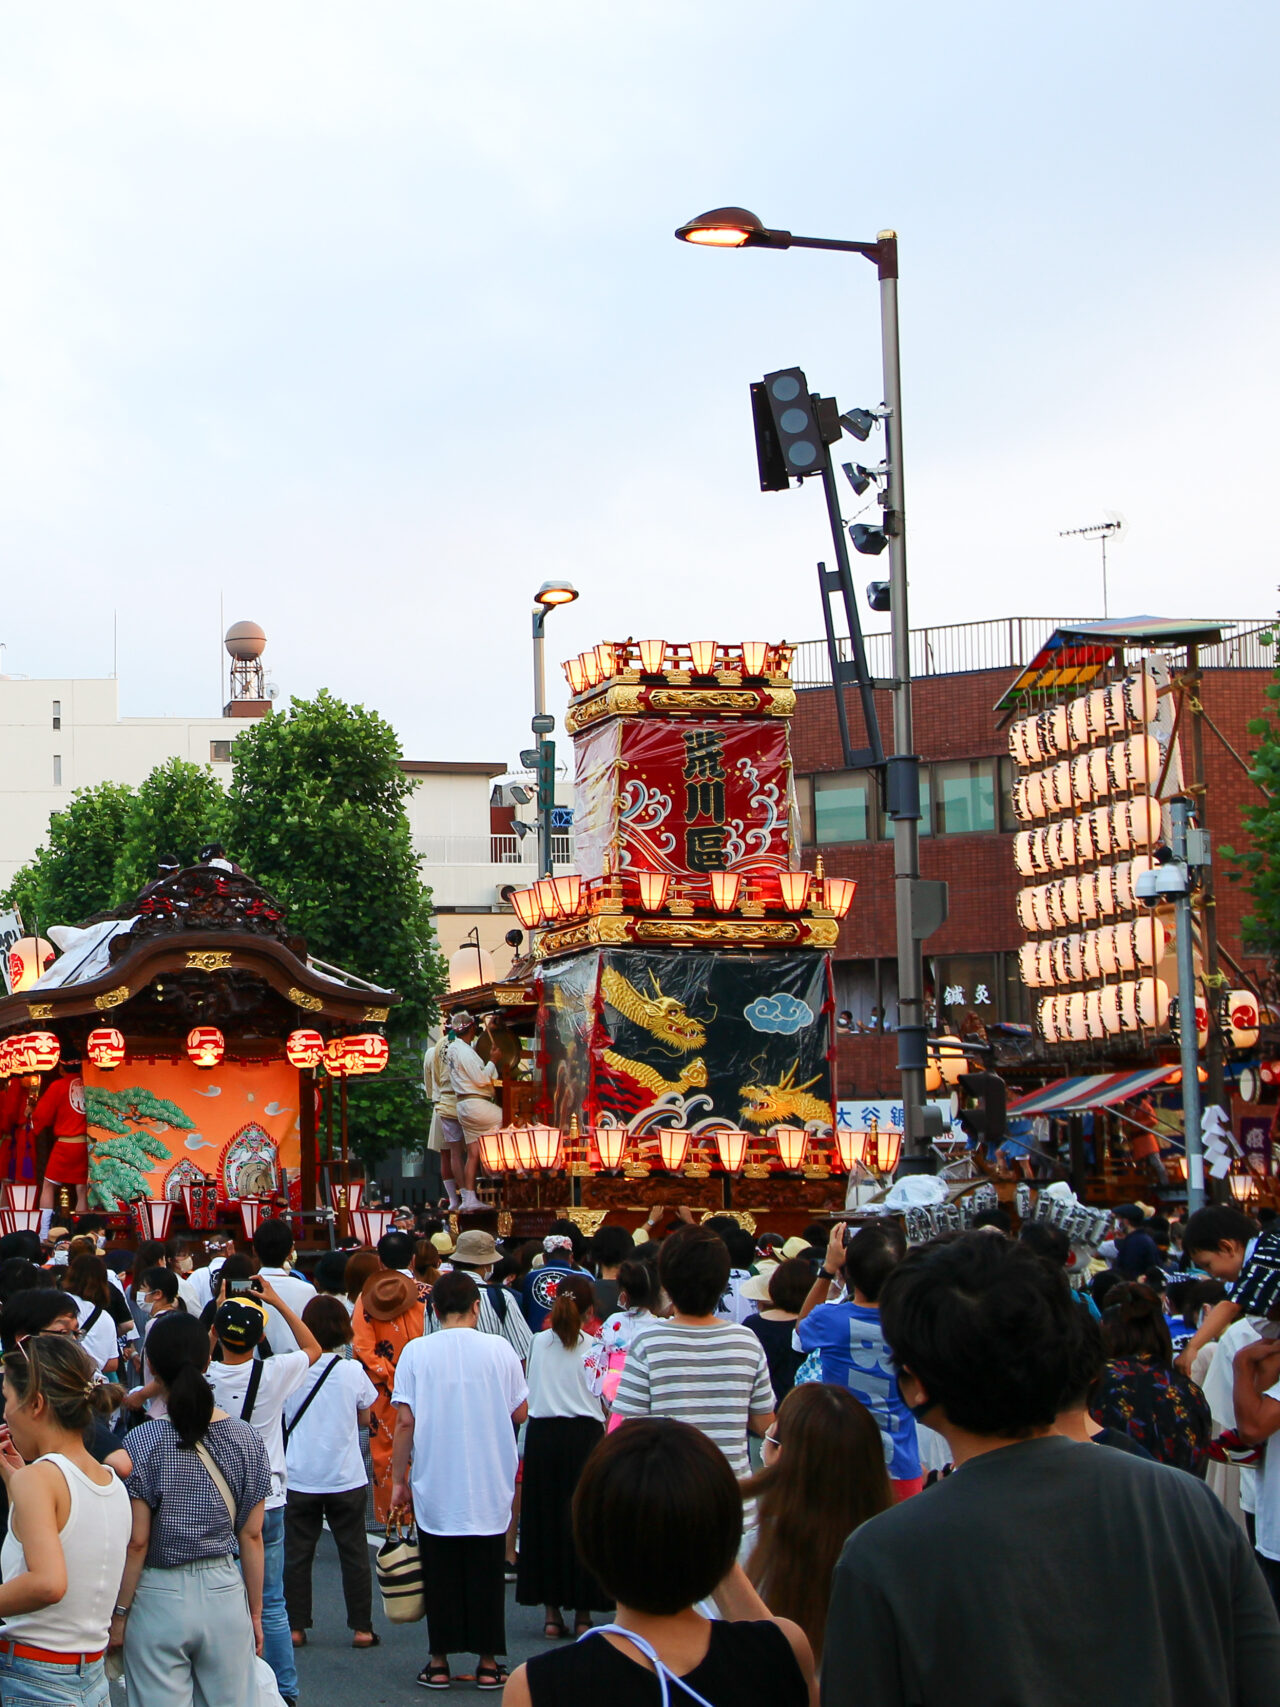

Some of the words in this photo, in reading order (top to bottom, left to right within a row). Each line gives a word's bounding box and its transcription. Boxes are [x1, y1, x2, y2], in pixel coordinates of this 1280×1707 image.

[682, 729, 728, 872] 荒川區
[943, 984, 992, 1006] 鍼灸
